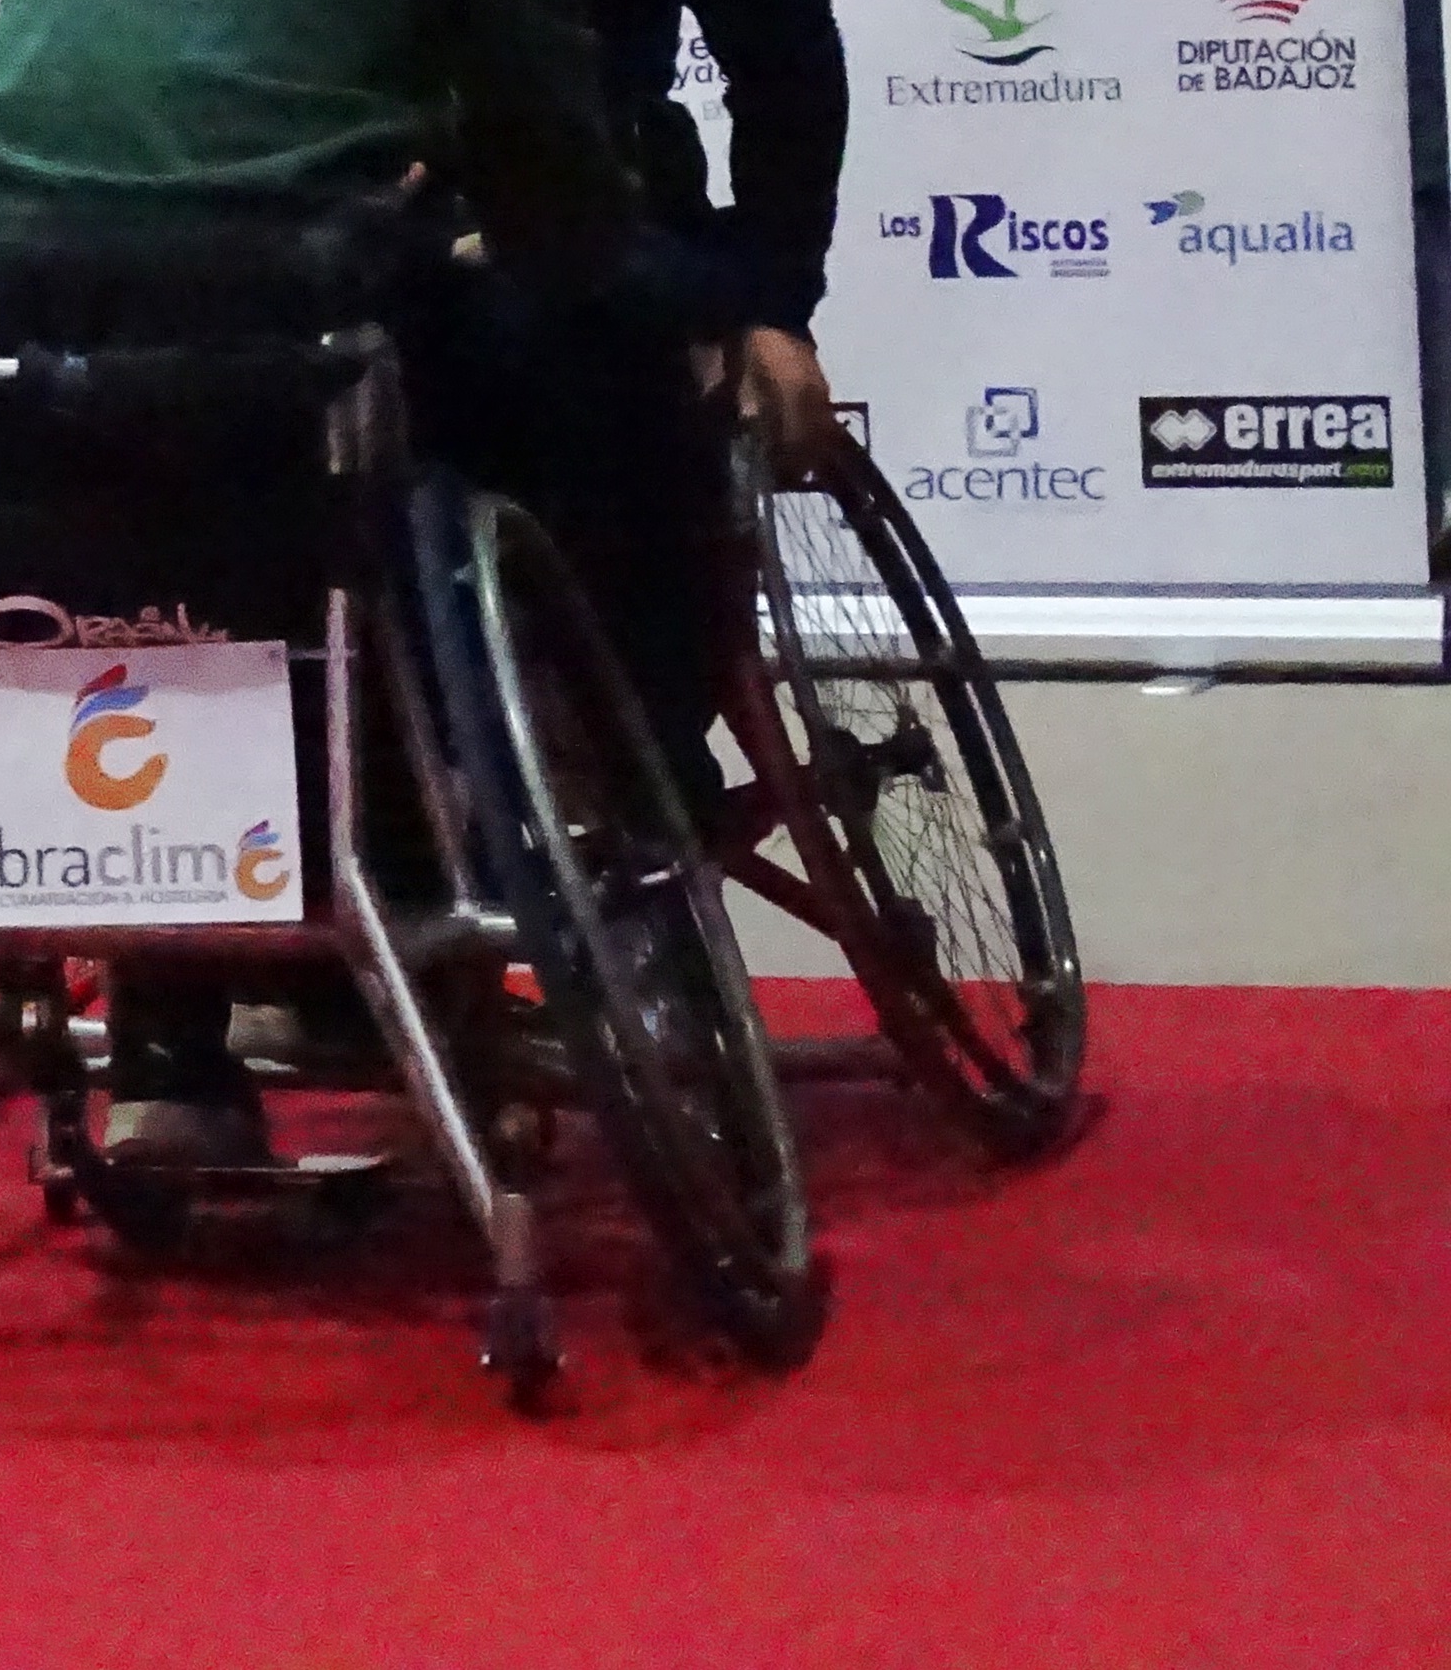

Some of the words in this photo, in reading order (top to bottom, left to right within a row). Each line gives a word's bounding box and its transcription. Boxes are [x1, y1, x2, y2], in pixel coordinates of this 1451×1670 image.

[1177, 30, 1356, 67] DIPUTACIÓN
[887, 72, 1122, 106] Extremadura
[1178, 74, 1204, 92] DE
[1215, 64, 1356, 91] BADAJOZ
[1178, 211, 1355, 265] aqualia
[1223, 404, 1388, 450] errea
[905, 459, 1106, 502] acentec
